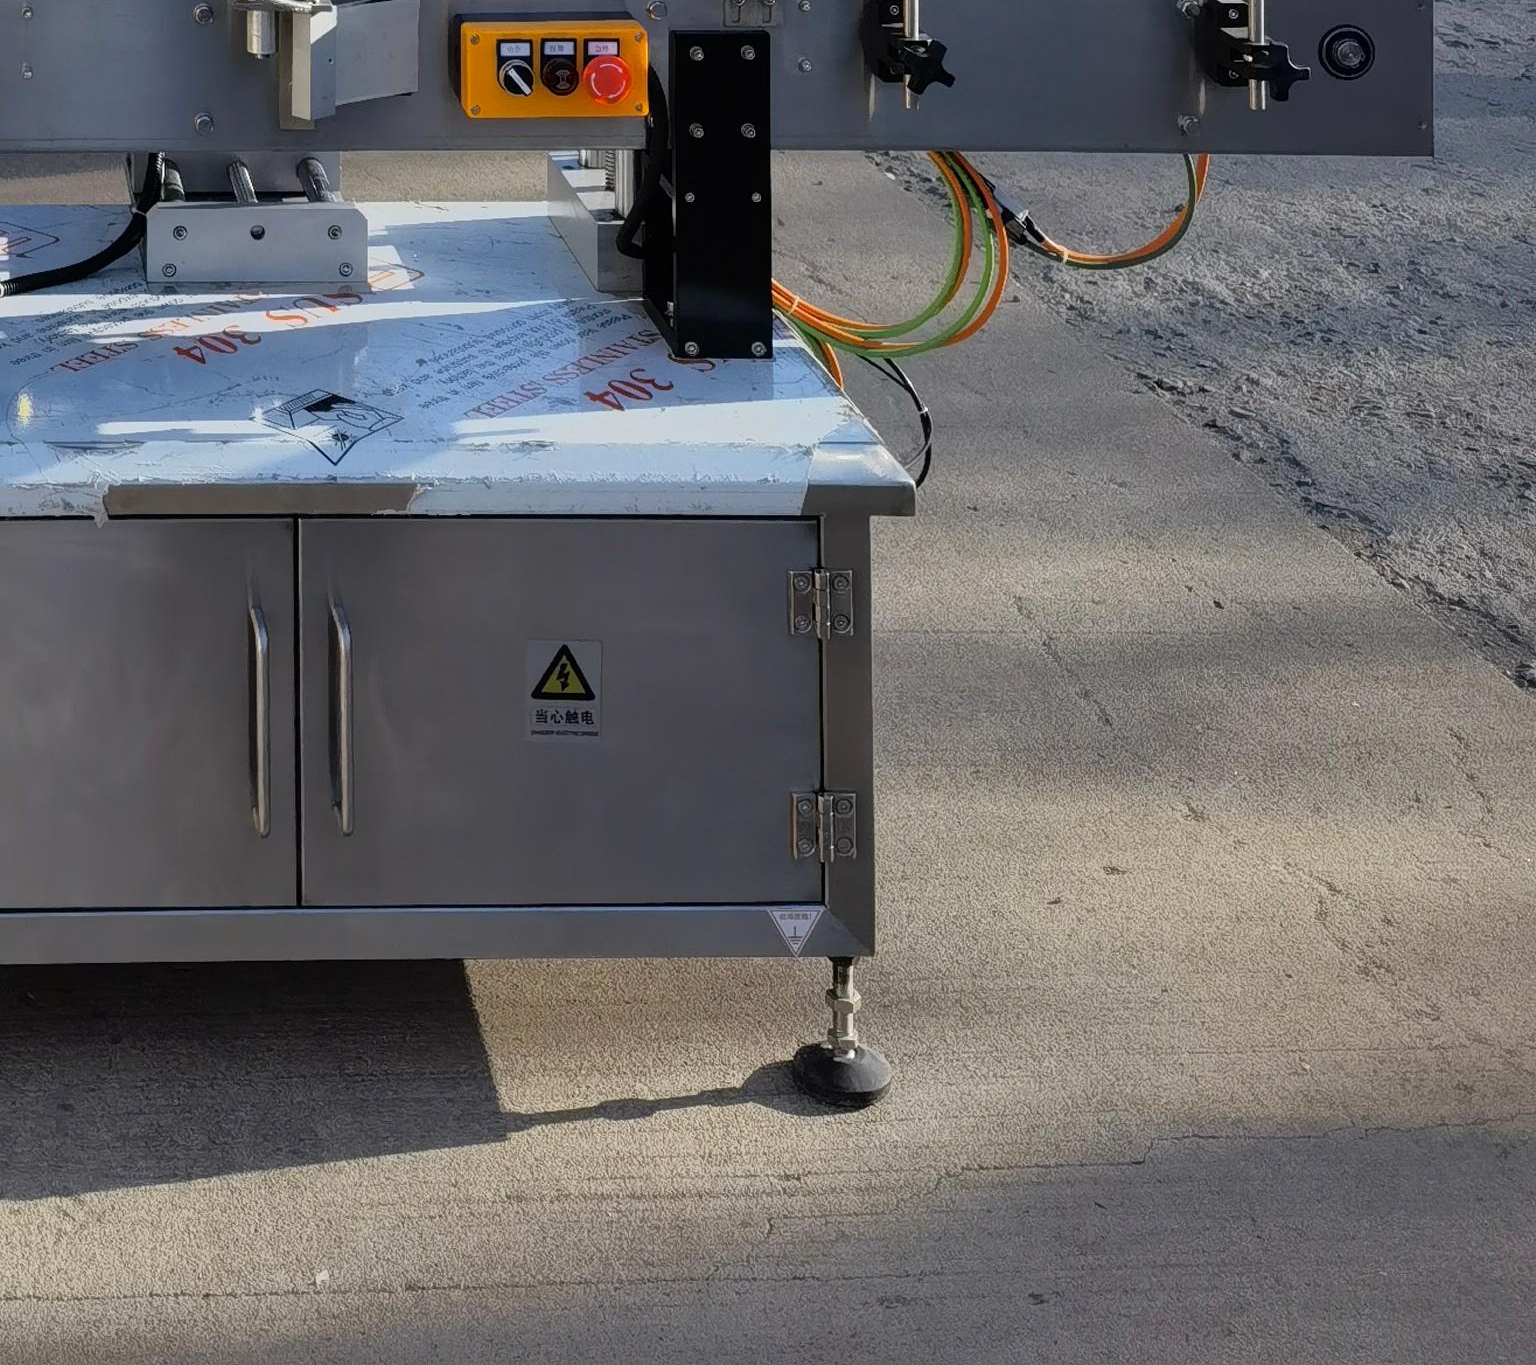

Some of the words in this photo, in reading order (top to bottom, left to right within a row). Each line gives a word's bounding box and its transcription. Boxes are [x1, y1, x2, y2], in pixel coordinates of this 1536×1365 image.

[51, 340, 141, 373] STEEL
[172, 325, 262, 364] 304
[543, 328, 664, 386] STAINLESS
[464, 380, 549, 420] STEEL
[583, 367, 675, 411] 304
[535, 709, 594, 725] 当心触电
